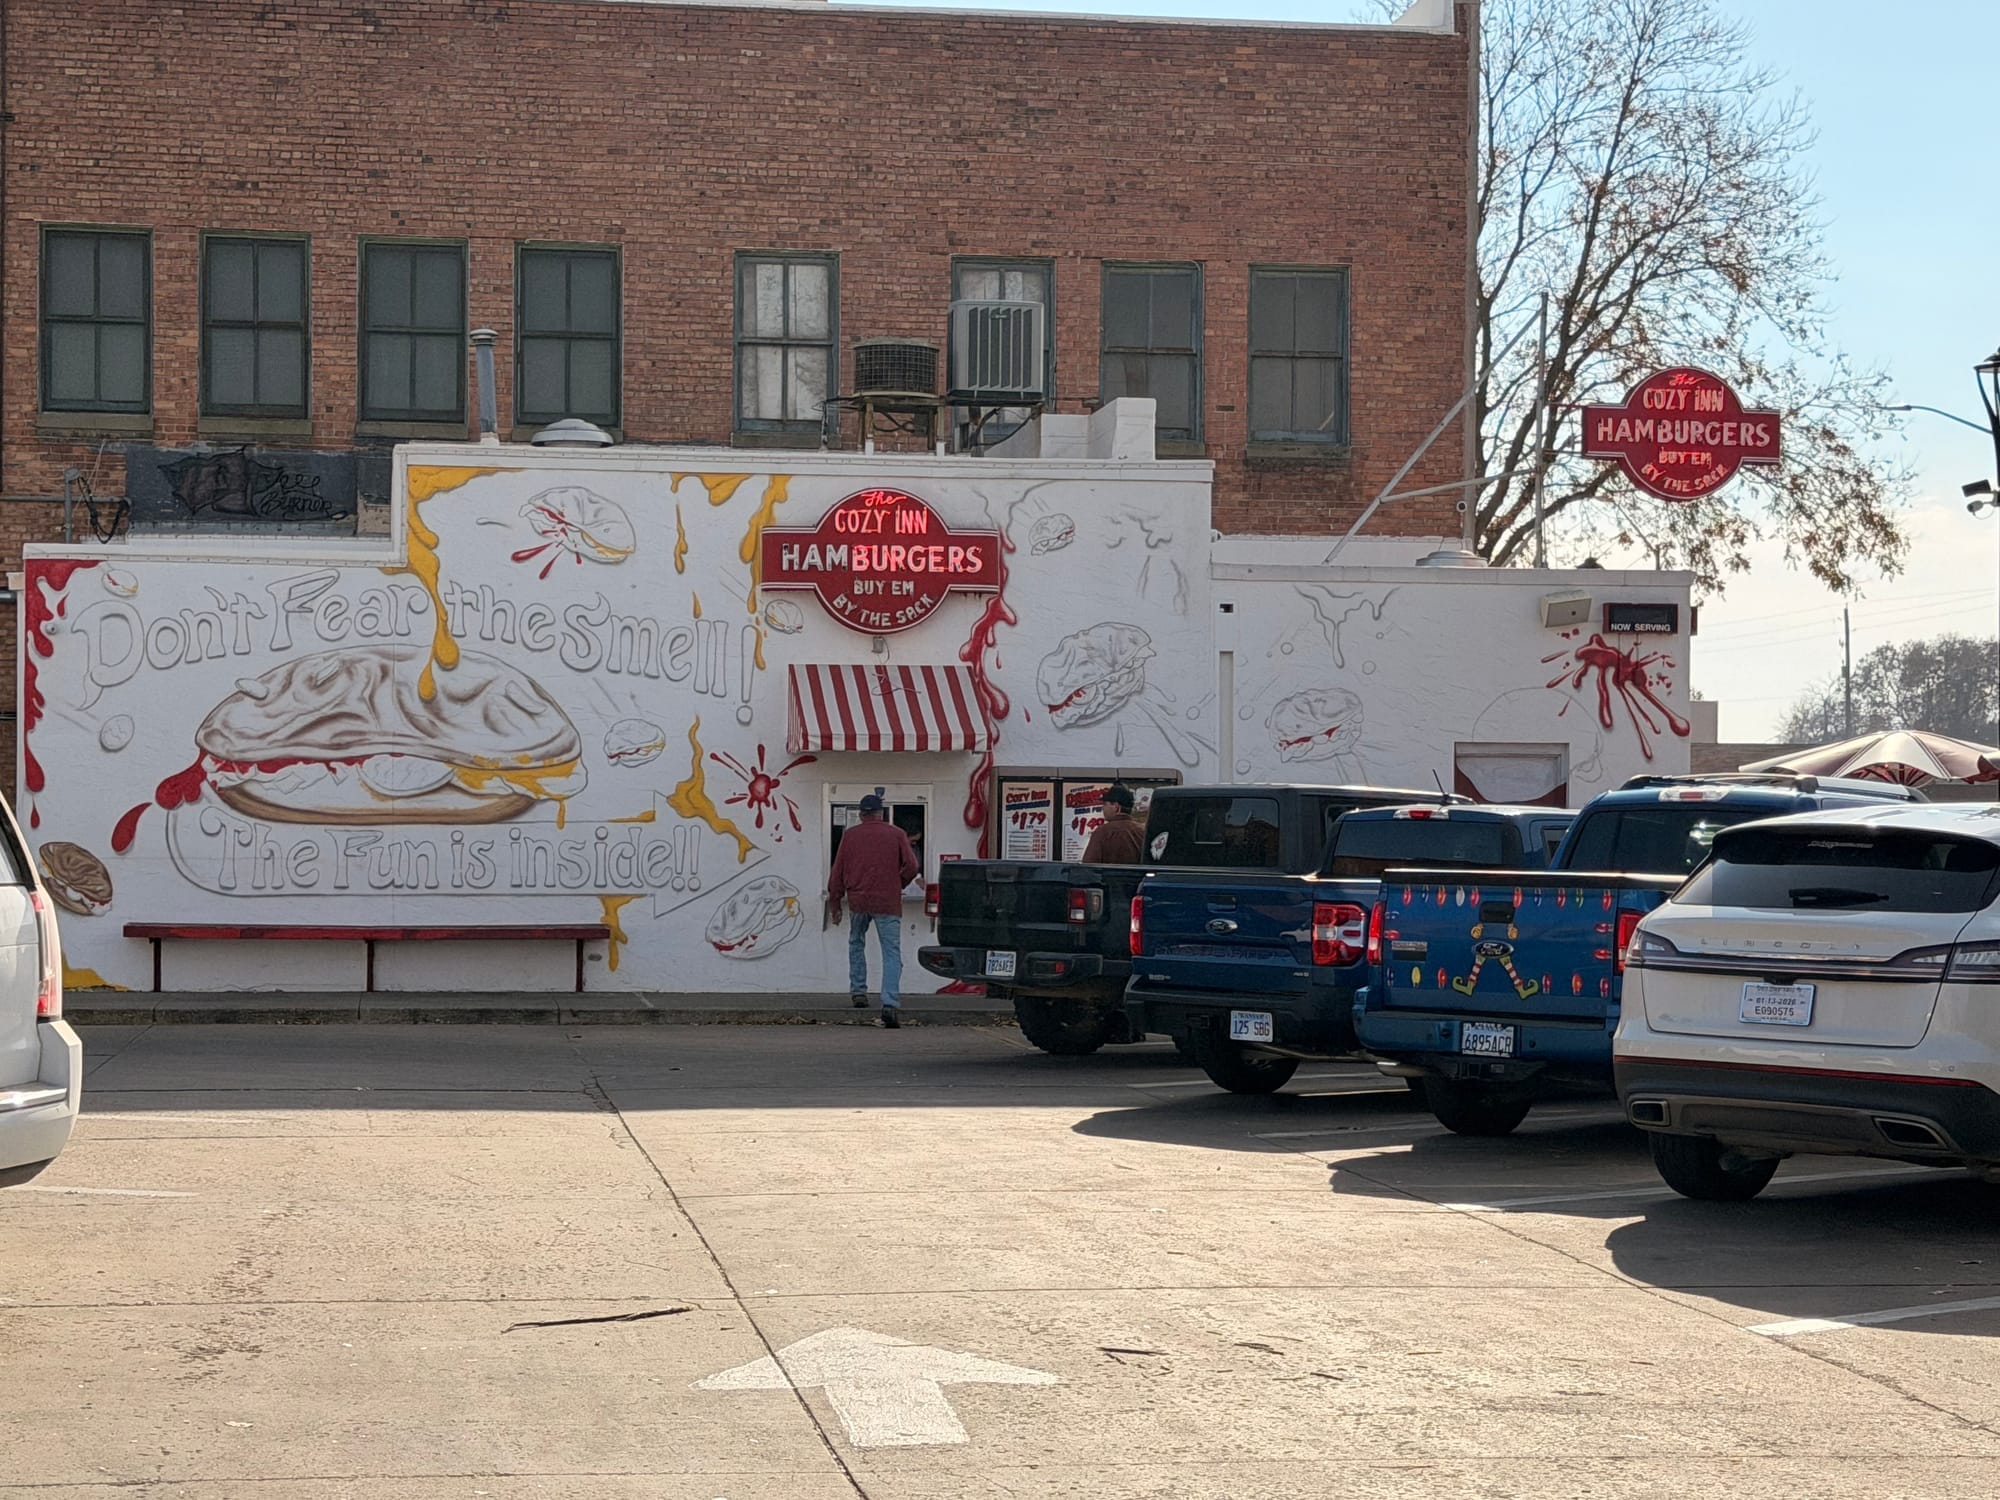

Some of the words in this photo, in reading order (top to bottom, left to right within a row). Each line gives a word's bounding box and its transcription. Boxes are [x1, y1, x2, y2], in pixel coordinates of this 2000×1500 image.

[1643, 387, 1690, 410] COZY
[1694, 385, 1724, 412] INN
[1597, 417, 1771, 448] HAMBURGERS
[1658, 448, 1690, 465] BUY
[1641, 462, 1665, 482] BY
[1663, 476, 1691, 492] THE
[1694, 464, 1728, 491] SACK
[861, 491, 907, 507] The
[834, 508, 891, 533] COZY
[895, 505, 928, 534] INN
[782, 543, 983, 573] HAMBURGERS
[853, 580, 886, 595] BUY
[891, 580, 914, 596] EM
[832, 593, 857, 615] BY
[859, 608, 891, 627] THE
[896, 595, 934, 623] SACK
[1610, 623, 1632, 631] NOW
[1634, 623, 1671, 632] SERVING
[71, 585, 267, 711] Don't
[265, 568, 429, 652] Fear
[444, 580, 556, 652] the
[559, 591, 756, 726] Smell!
[199, 805, 320, 890] The
[323, 829, 440, 889] Fun
[450, 829, 497, 889] is
[508, 824, 701, 892] inside!!
[1754, 1005, 1795, 1017] E090575
[1233, 1020, 1249, 1035] 125
[1253, 1021, 1270, 1037] SBG
[1465, 1033, 1512, 1053] 6895ACR
